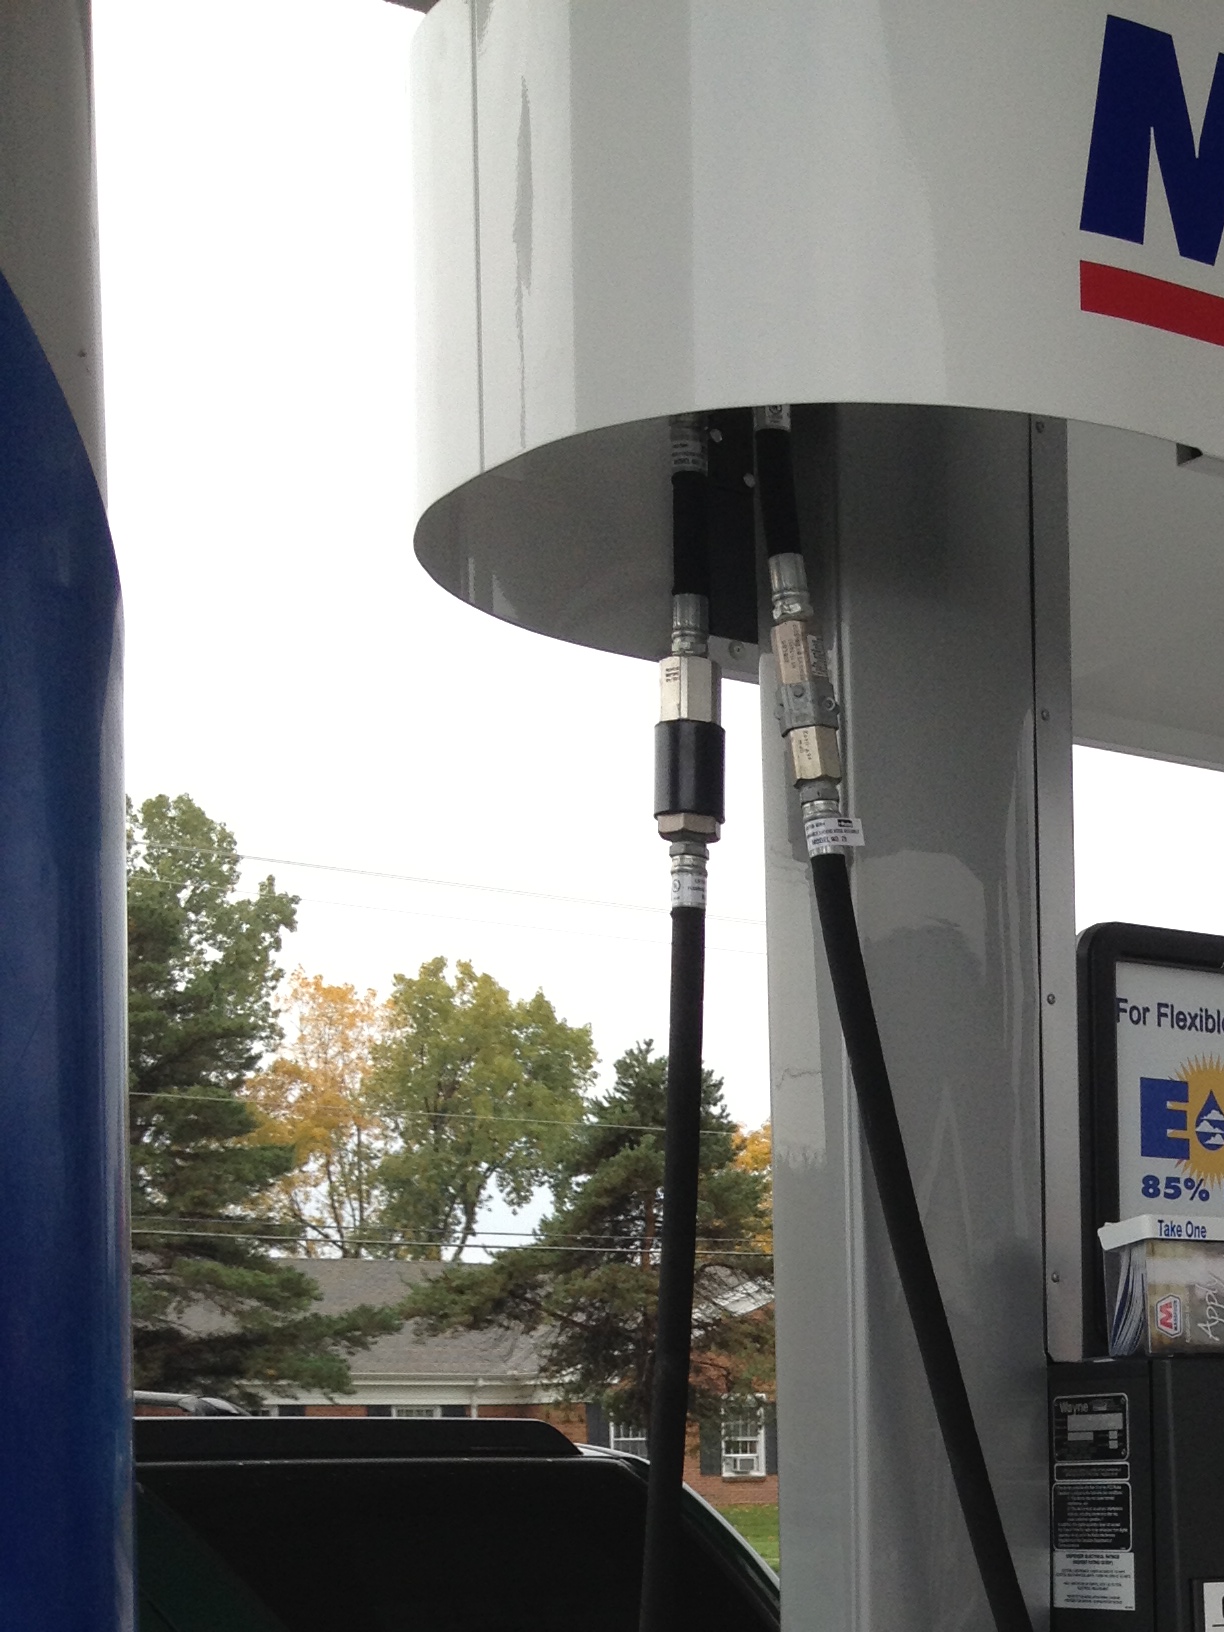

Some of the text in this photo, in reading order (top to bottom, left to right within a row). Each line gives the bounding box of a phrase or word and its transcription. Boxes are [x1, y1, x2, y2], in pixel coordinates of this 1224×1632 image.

[1117, 998, 1150, 1026] For
[1141, 1175, 1209, 1202] 85%
[1157, 1220, 1207, 1239] Take One
